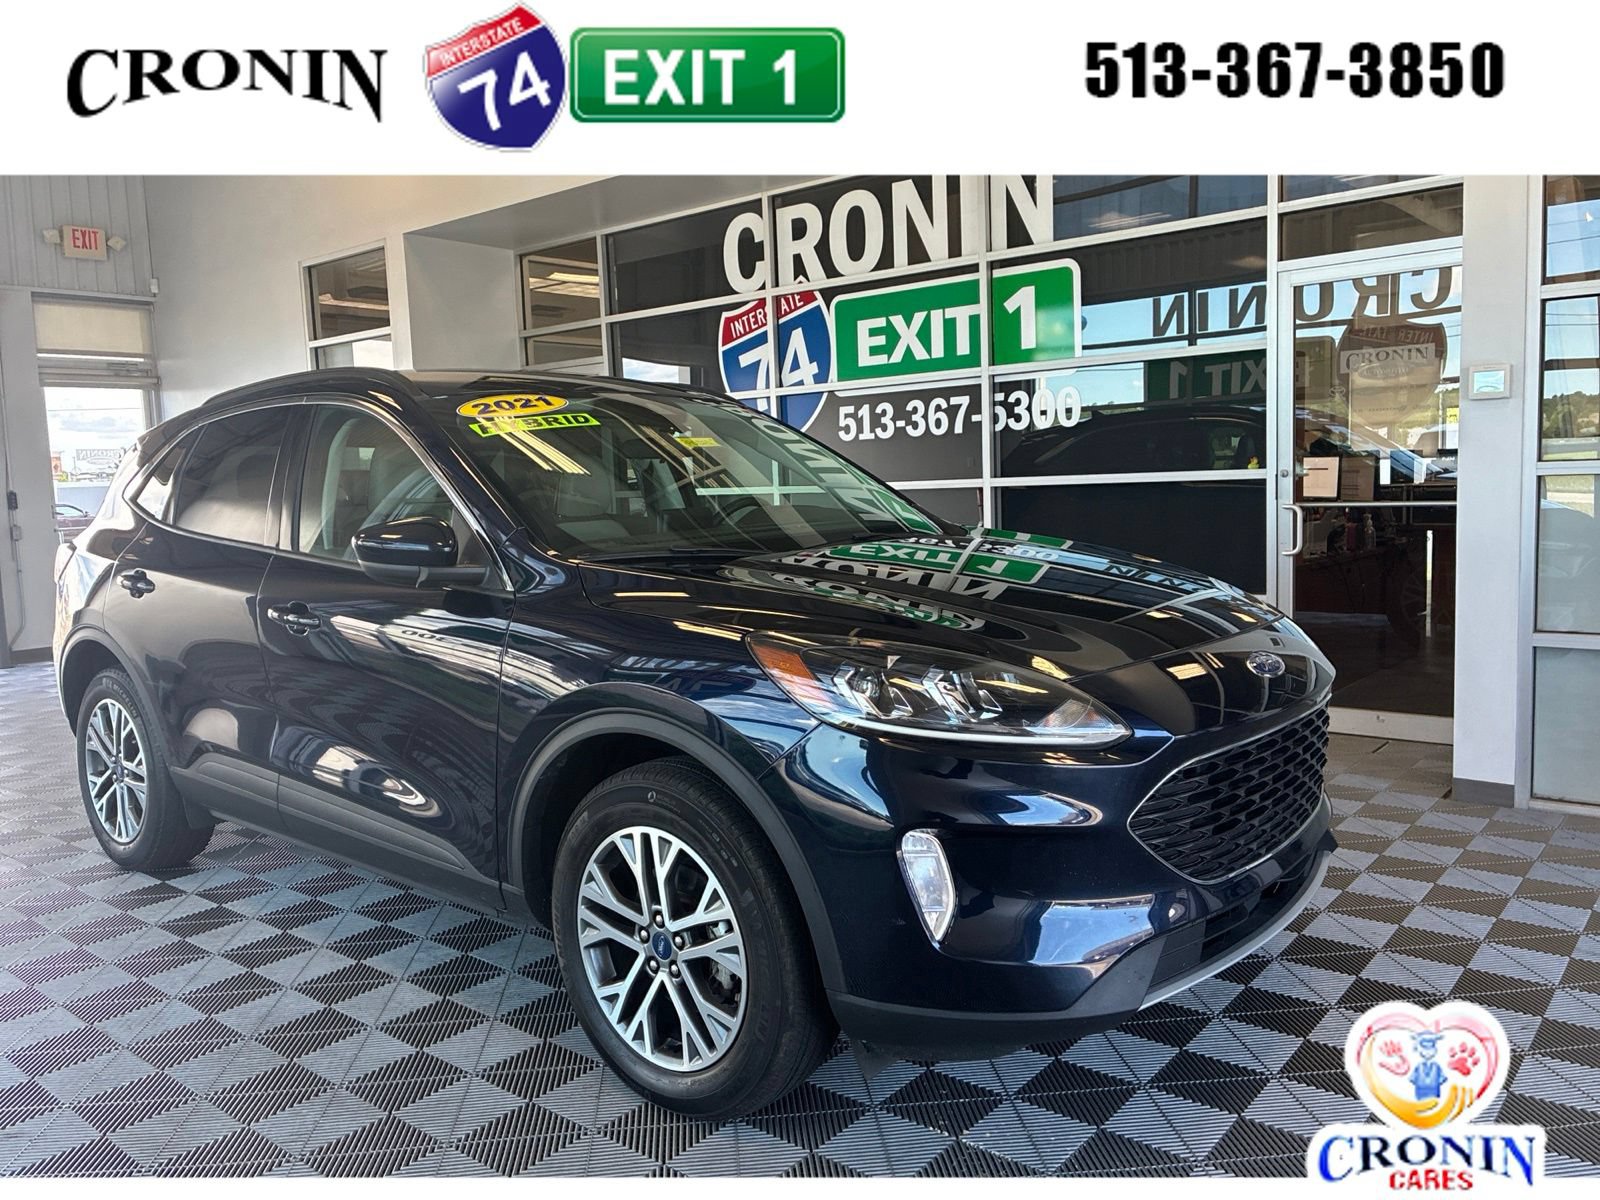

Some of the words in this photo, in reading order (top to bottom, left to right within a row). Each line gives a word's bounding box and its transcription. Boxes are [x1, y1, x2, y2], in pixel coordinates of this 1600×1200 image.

[71, 228, 100, 251] EXIT
[723, 175, 1053, 294] CRONIN
[857, 304, 981, 367] EXIT
[1003, 285, 1037, 350] 1
[471, 396, 554, 415] 2021
[738, 327, 819, 412] 74
